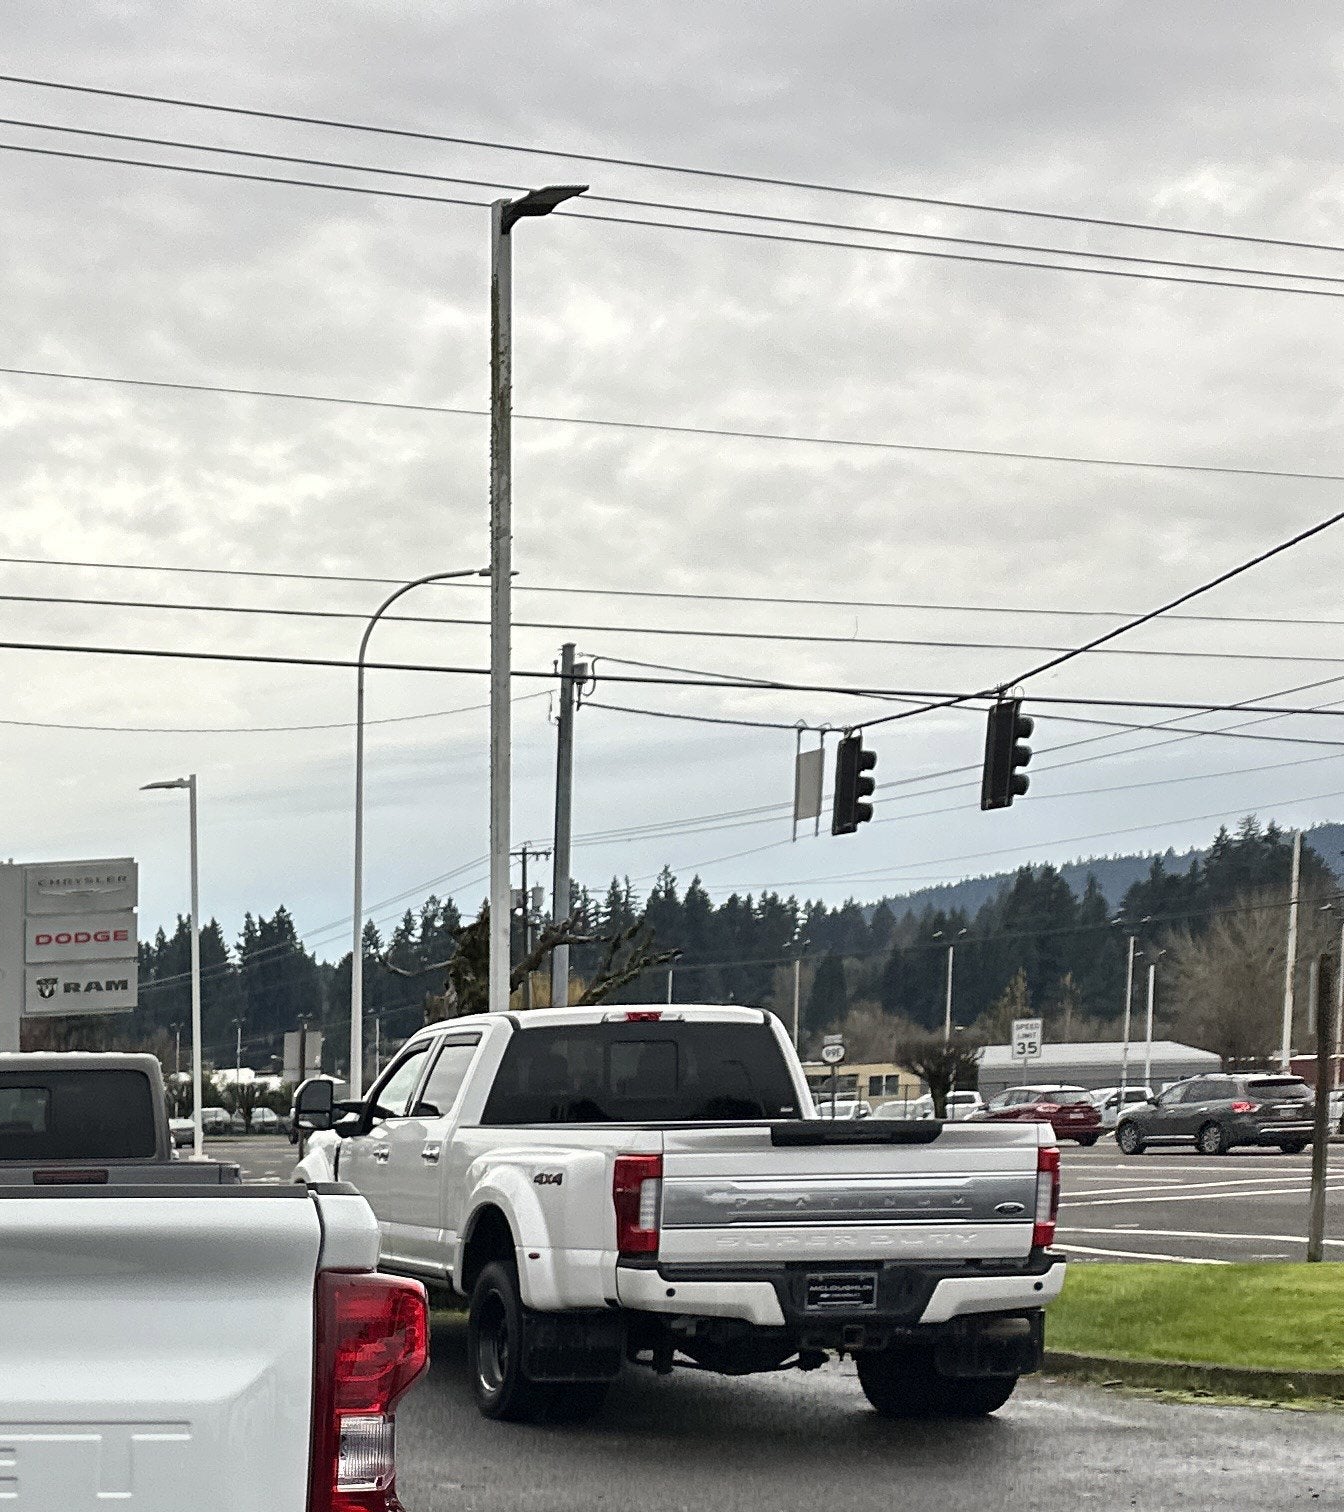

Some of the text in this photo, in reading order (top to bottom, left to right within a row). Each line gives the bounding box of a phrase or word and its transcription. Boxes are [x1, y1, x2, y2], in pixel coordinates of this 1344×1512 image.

[35, 929, 129, 946] DODGE
[62, 979, 129, 994] RAM
[1015, 1022, 1040, 1031] SPEED
[1016, 1041, 1038, 1055] 35
[714, 1232, 979, 1248] SUPER DUTY
